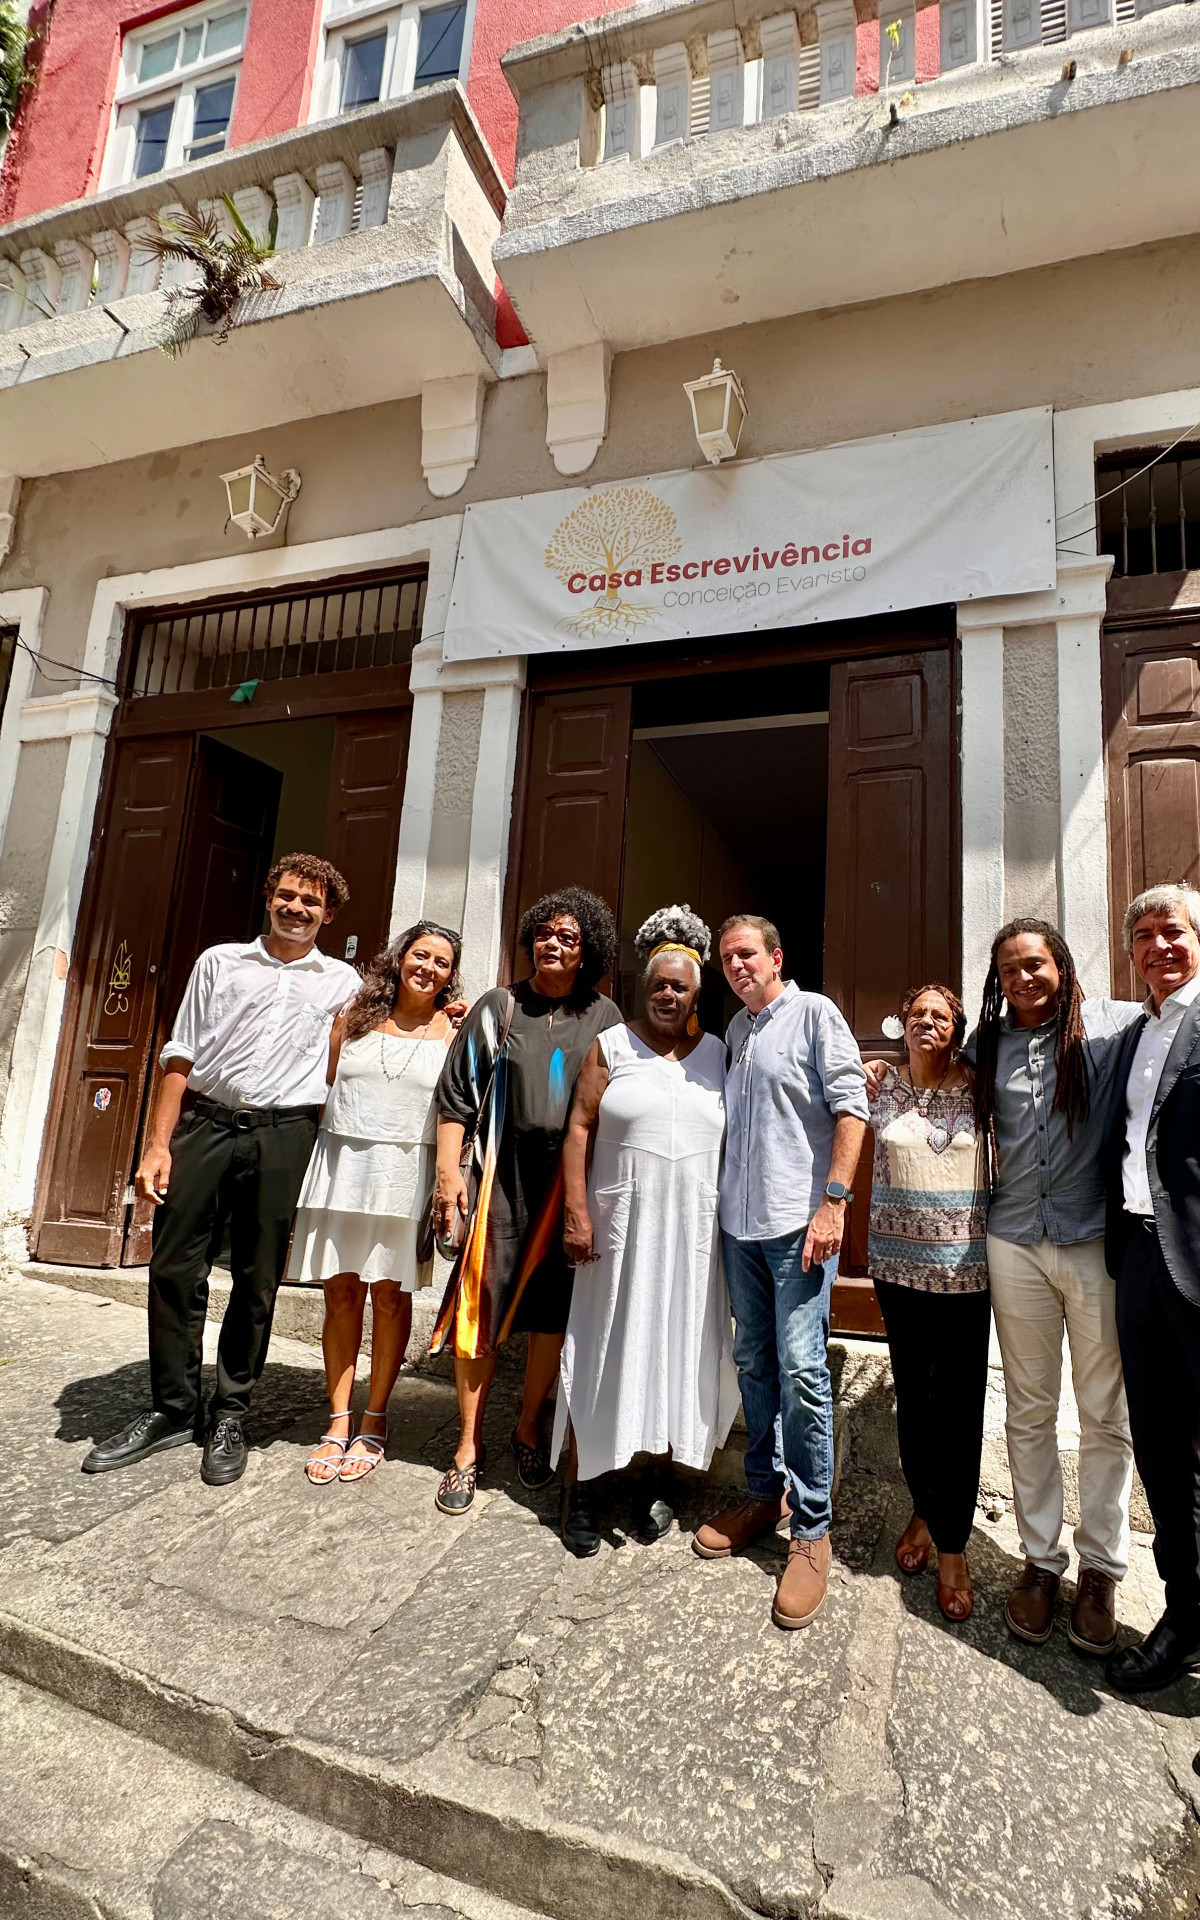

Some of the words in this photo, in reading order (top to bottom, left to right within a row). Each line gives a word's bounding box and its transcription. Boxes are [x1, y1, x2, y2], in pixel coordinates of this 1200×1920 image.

[567, 569, 642, 594] Casa
[650, 534, 872, 584] Escrevivência
[663, 580, 771, 608] Conceição
[776, 564, 867, 594] Evaristo
